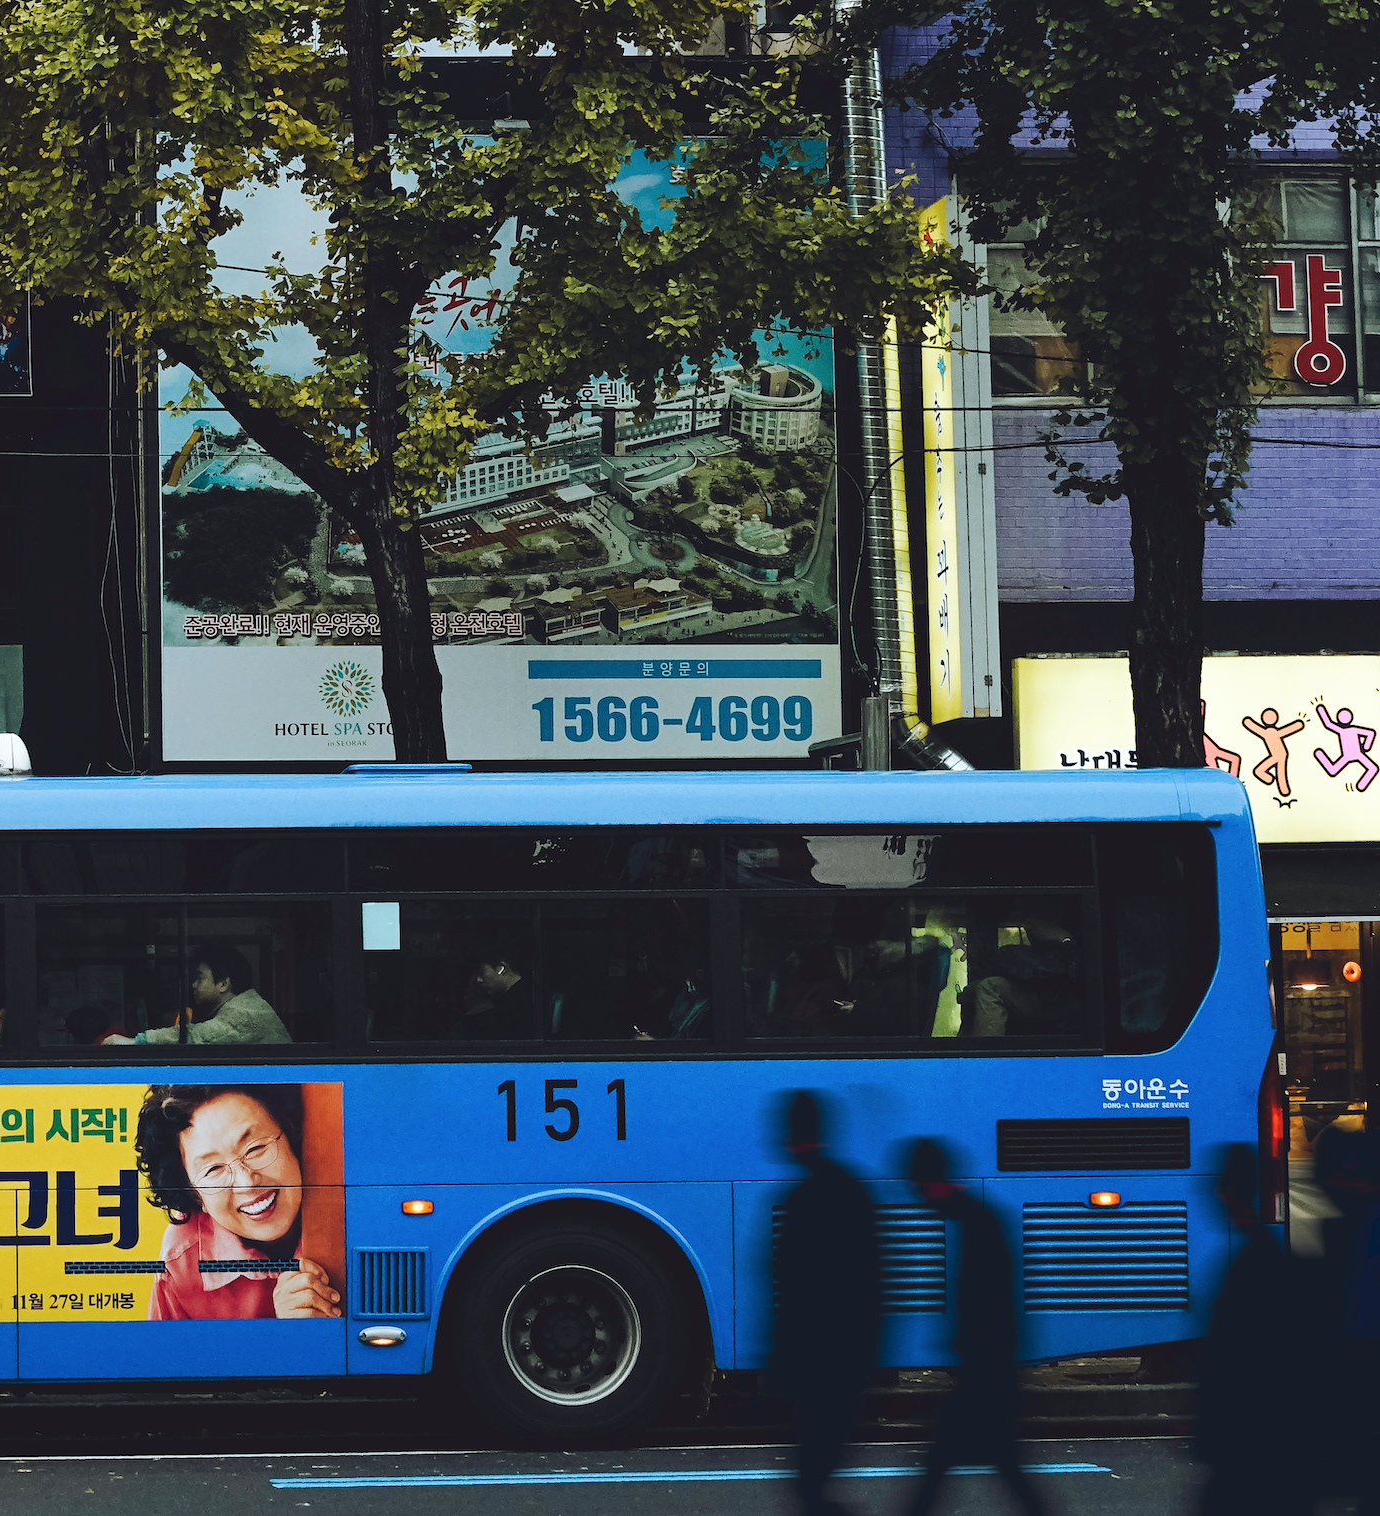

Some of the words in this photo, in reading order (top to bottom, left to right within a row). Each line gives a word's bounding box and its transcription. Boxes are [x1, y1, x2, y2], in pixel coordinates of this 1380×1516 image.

[183, 612, 271, 637] 준공완료!!
[274, 612, 310, 636] 현재
[450, 611, 524, 636] 온천호텔
[274, 722, 330, 737] HOTEL
[333, 722, 361, 737] SPA
[531, 694, 814, 743] 1566-4699
[335, 740, 369, 748] SEORAK
[1101, 1077, 1190, 1101] 동아운수
[497, 1078, 627, 1142] 151
[45, 1107, 129, 1144] 시작!
[10, 1292, 44, 1312] 11월
[48, 1292, 85, 1311] 27일
[88, 1291, 136, 1310] 대개봉
